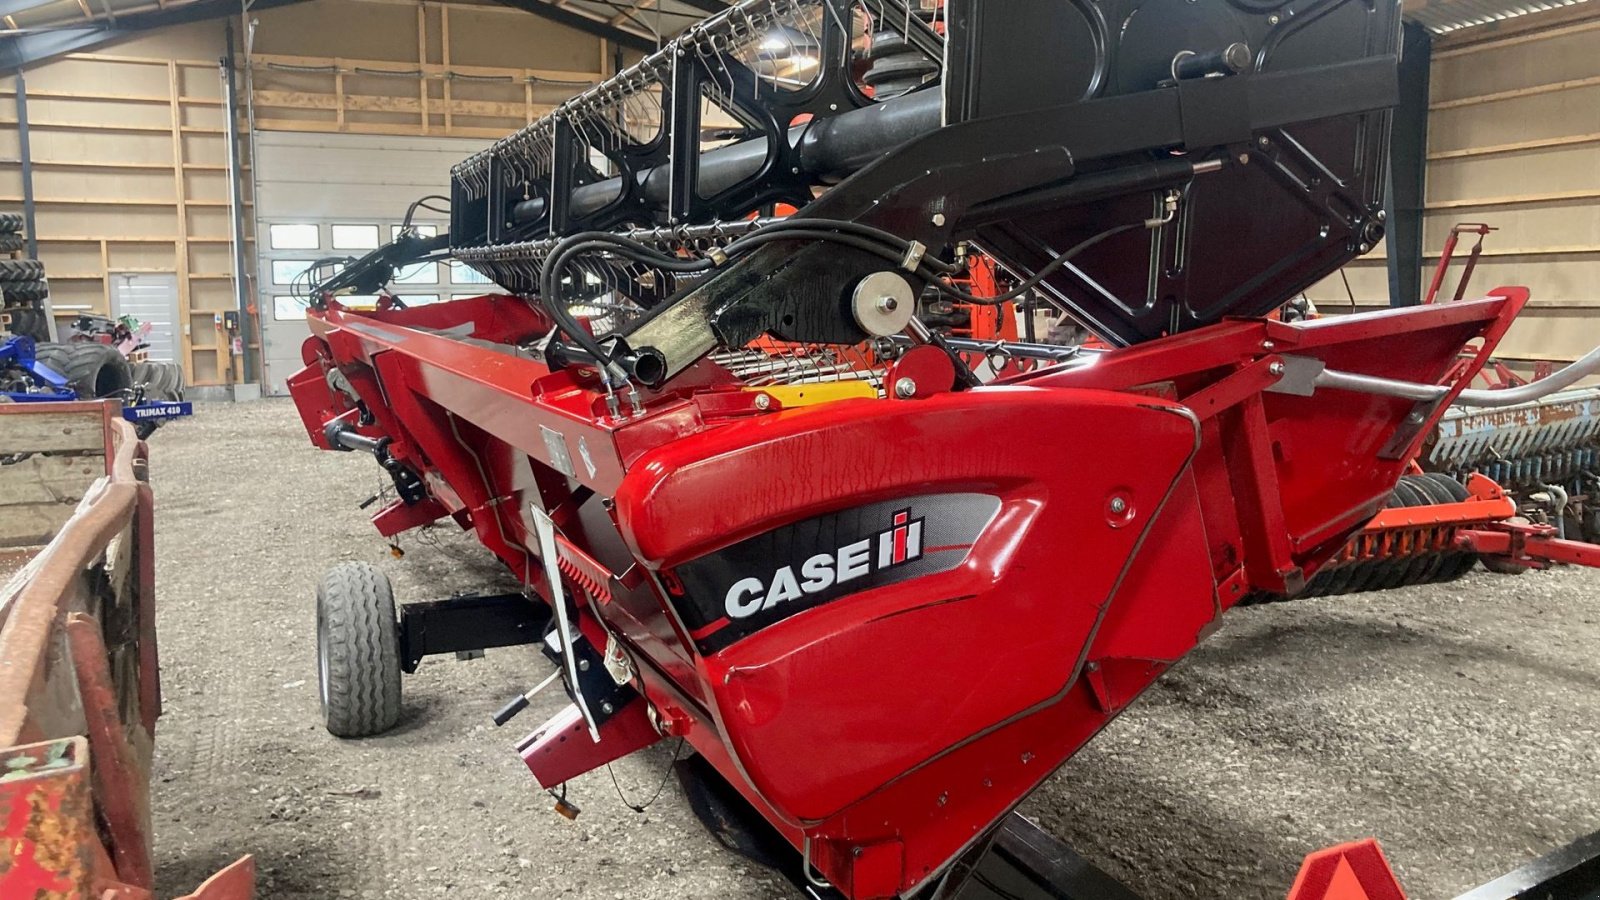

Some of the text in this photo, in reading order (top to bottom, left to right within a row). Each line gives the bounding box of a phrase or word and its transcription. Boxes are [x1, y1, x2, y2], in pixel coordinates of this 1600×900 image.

[136, 406, 181, 417] TRIMAX 410
[724, 538, 870, 618] CASE
